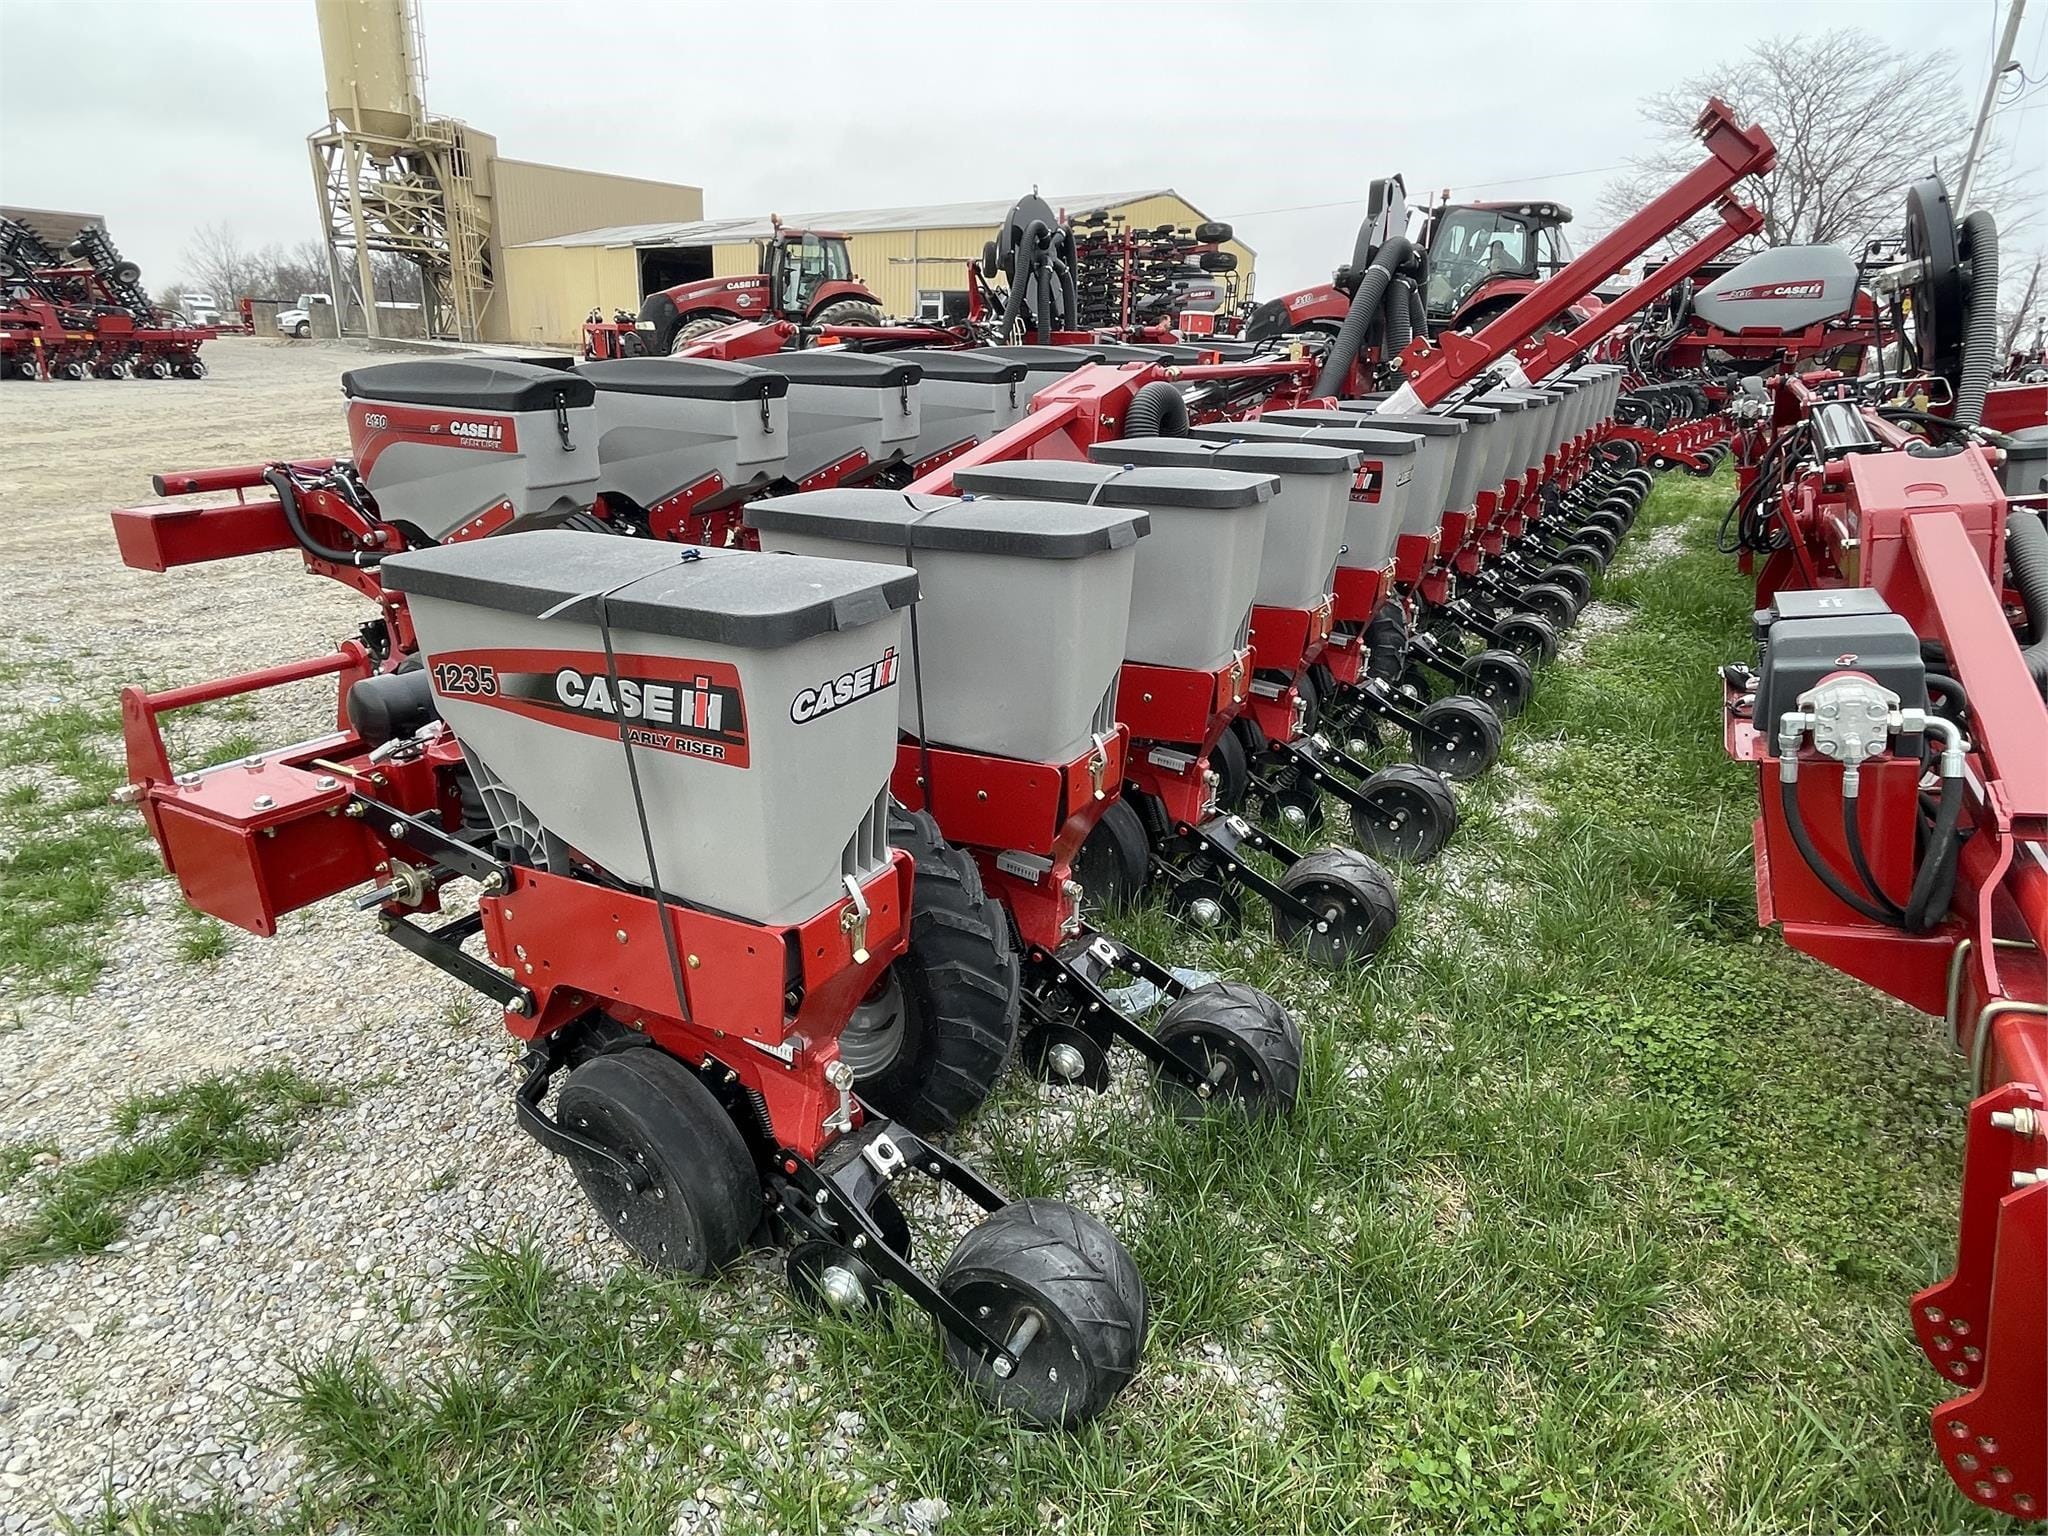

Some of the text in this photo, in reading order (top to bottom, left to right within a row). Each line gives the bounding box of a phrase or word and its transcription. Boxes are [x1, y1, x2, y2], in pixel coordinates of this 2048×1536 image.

[727, 280, 751, 290] CASE
[1774, 286, 1809, 296] CASE
[450, 420, 488, 438] CASE
[434, 663, 498, 697] 1235
[555, 668, 674, 724] CASE
[790, 664, 873, 724] CASE
[620, 727, 725, 760] ARLY RISER
